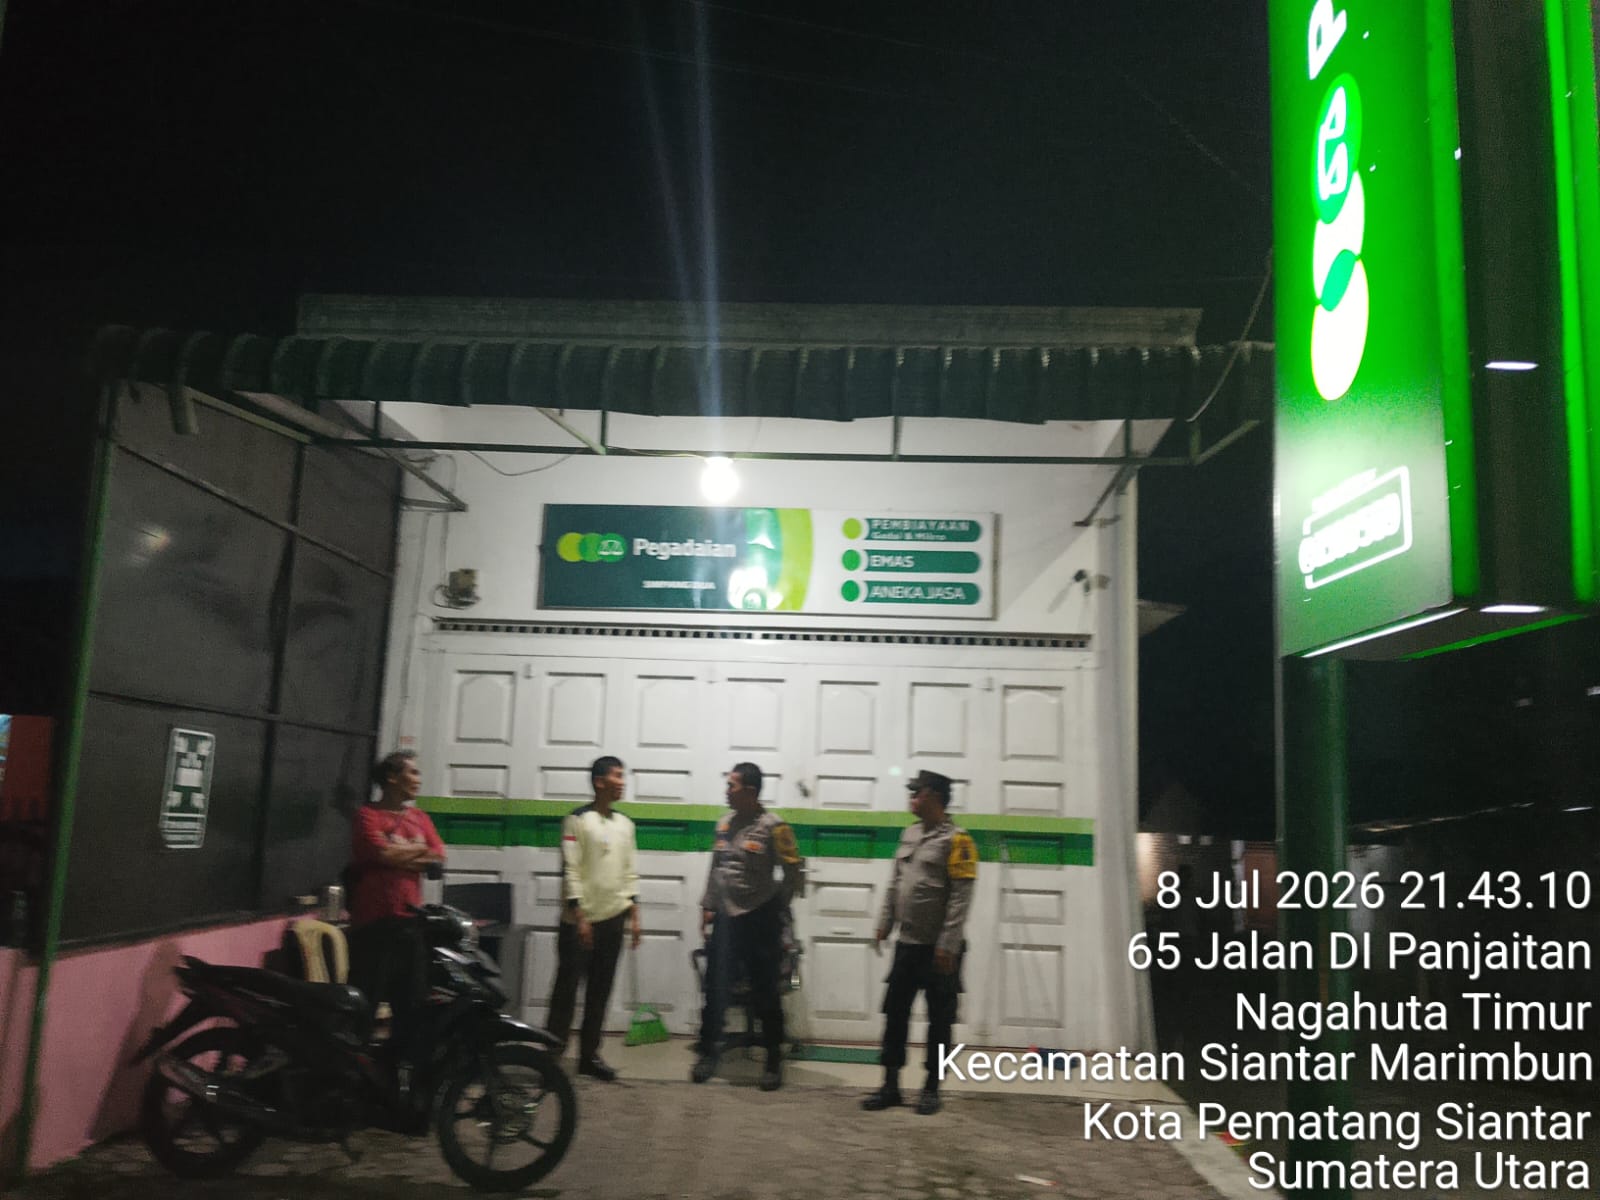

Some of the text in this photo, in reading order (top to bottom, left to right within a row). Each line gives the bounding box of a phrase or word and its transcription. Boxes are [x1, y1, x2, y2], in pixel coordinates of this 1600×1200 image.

[632, 537, 737, 561] Pegadaian
[869, 554, 915, 568] EMAS
[869, 585, 966, 600] ANEKA JASA
